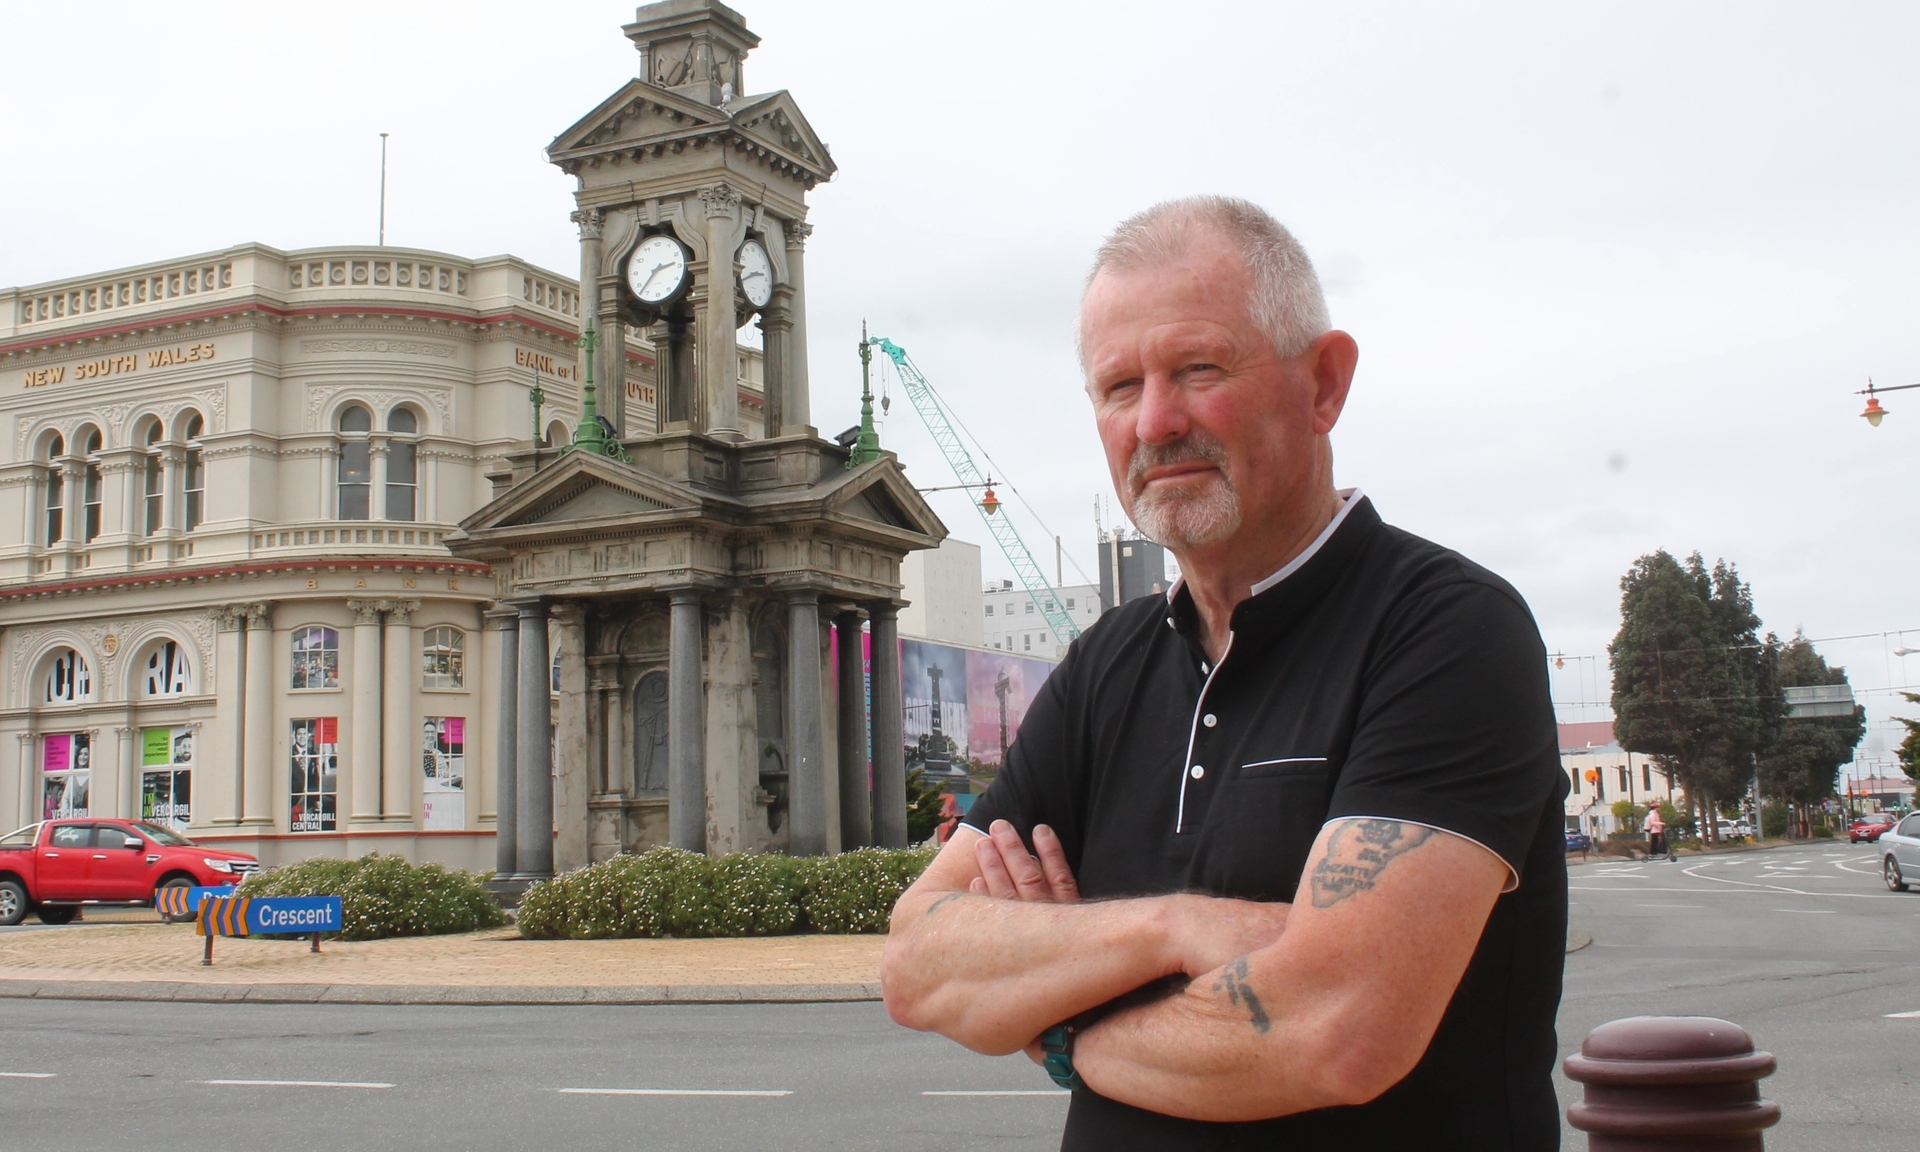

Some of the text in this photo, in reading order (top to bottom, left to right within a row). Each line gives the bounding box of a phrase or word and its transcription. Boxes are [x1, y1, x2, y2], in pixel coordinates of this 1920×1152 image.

[23, 343, 215, 388] NEW SOUTH WALES
[516, 347, 555, 375] BANK
[624, 381, 655, 404] UTH
[905, 696, 966, 738] CONFDENT
[259, 903, 333, 926] Crescent
